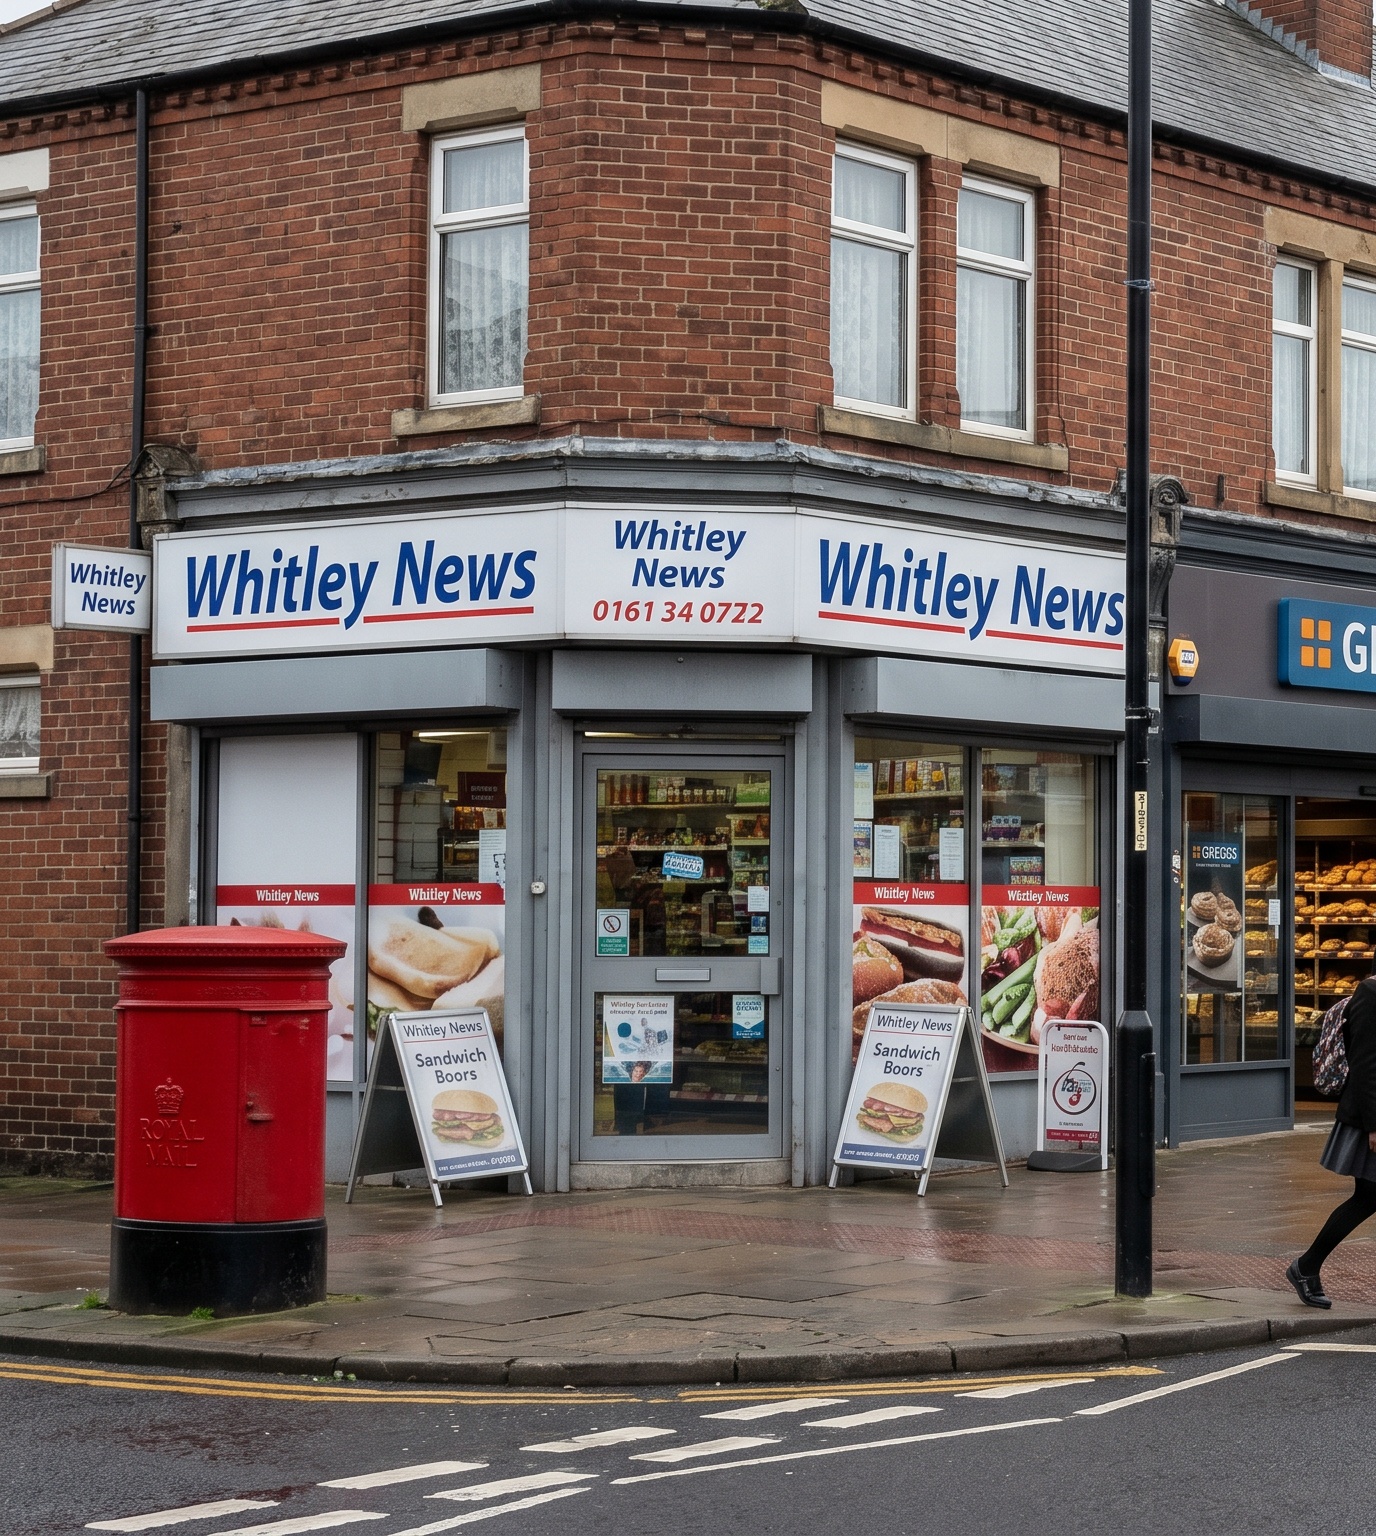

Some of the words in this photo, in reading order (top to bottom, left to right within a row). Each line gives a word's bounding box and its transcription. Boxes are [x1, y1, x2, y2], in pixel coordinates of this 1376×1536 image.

[614, 519, 747, 561] Whitley
[70, 562, 147, 595] Whitley
[631, 557, 726, 589] News
[186, 545, 379, 631] Whitley
[392, 539, 538, 607] News
[819, 538, 1000, 641] Whitley
[1010, 565, 1125, 636] News
[81, 591, 136, 616] News
[592, 599, 654, 622] 0161
[660, 601, 694, 623] 34
[699, 601, 764, 624] 0722
[1201, 845, 1238, 860] GREGGS
[293, 889, 320, 902] News
[408, 887, 450, 904] Whitley
[452, 888, 483, 901] News
[911, 887, 935, 900] News
[1045, 890, 1070, 902] News
[449, 1021, 483, 1035] News
[876, 1014, 920, 1032] Whitley
[921, 1018, 953, 1032] News
[415, 1047, 487, 1068] Sandwich
[873, 1042, 941, 1061] Sandwich
[434, 1069, 478, 1084] Boors
[883, 1060, 924, 1077] Boors
[139, 1117, 205, 1141] ROYAL
[145, 1143, 198, 1167] MAIL
